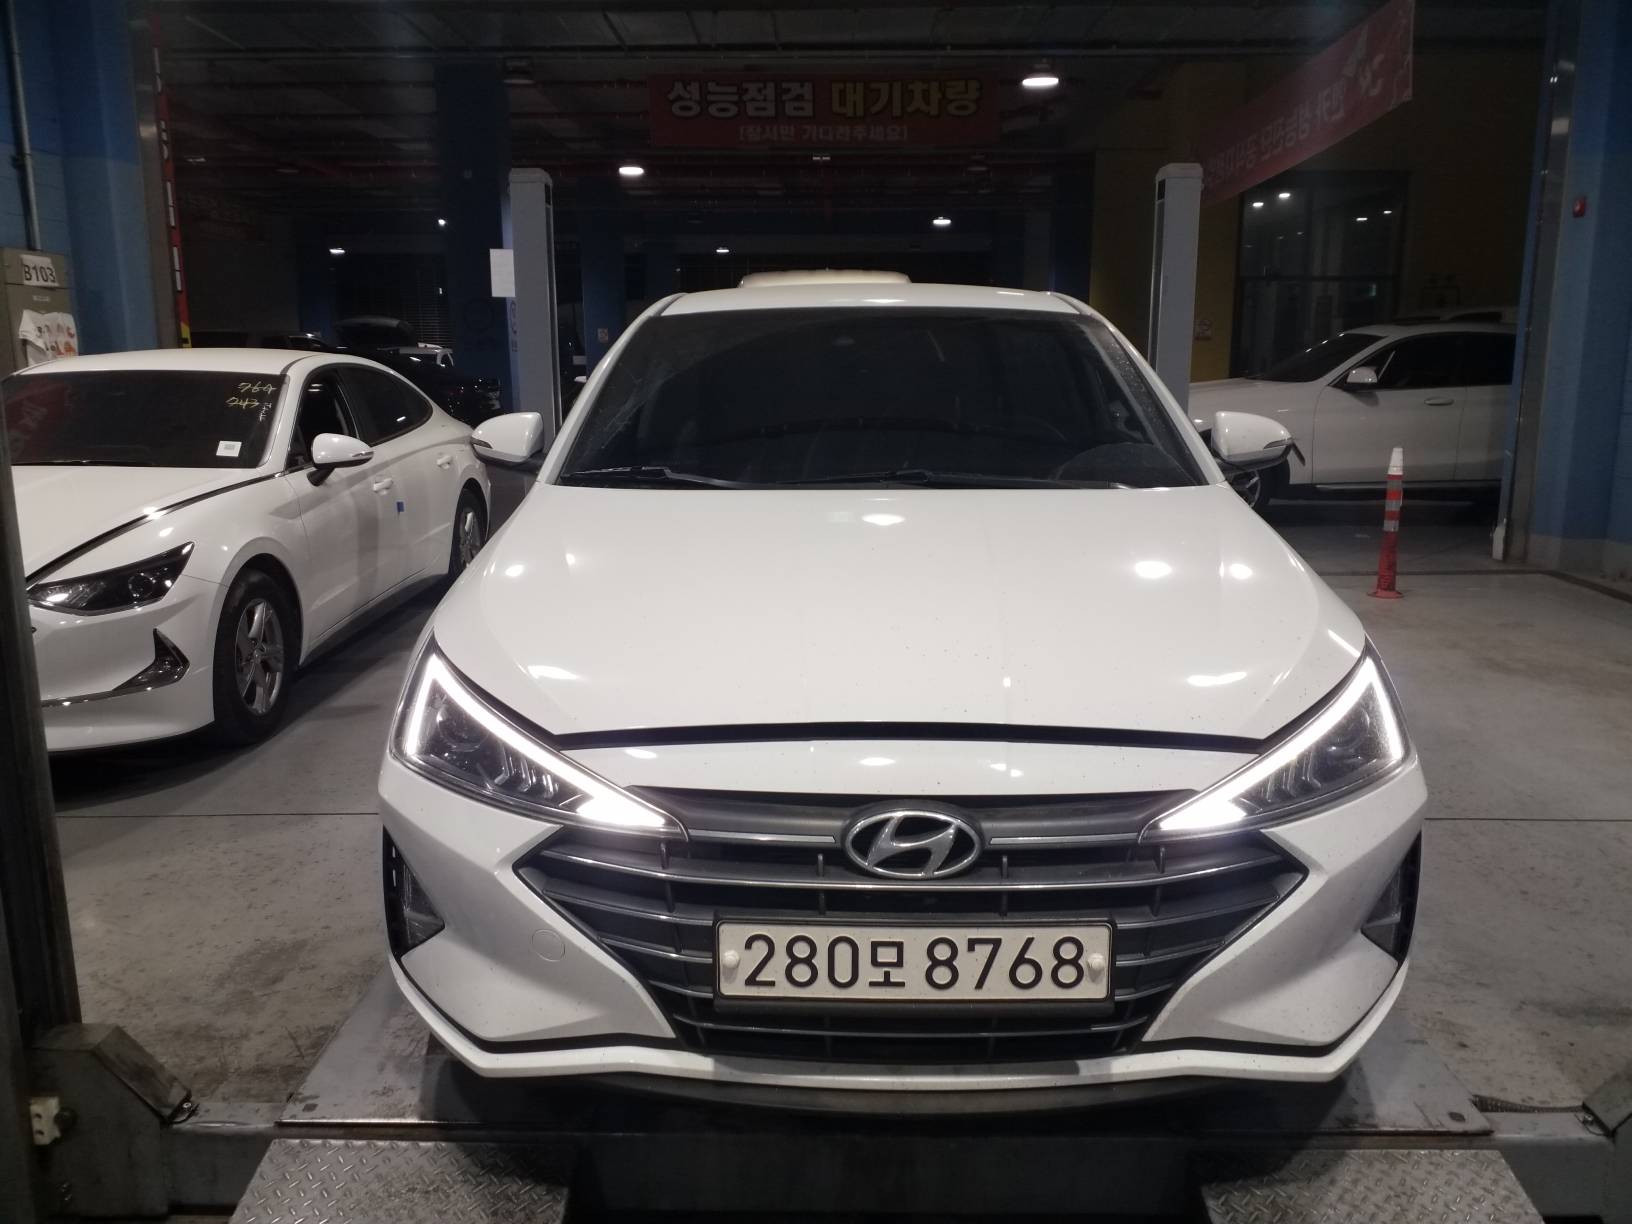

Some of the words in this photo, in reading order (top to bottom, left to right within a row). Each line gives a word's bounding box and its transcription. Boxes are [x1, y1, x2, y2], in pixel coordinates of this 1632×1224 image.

[667, 79, 814, 118] 성능점검
[831, 78, 981, 118] 대기차량
[24, 264, 56, 283] B103
[744, 934, 905, 988] 280모
[925, 936, 1085, 990] 8768
